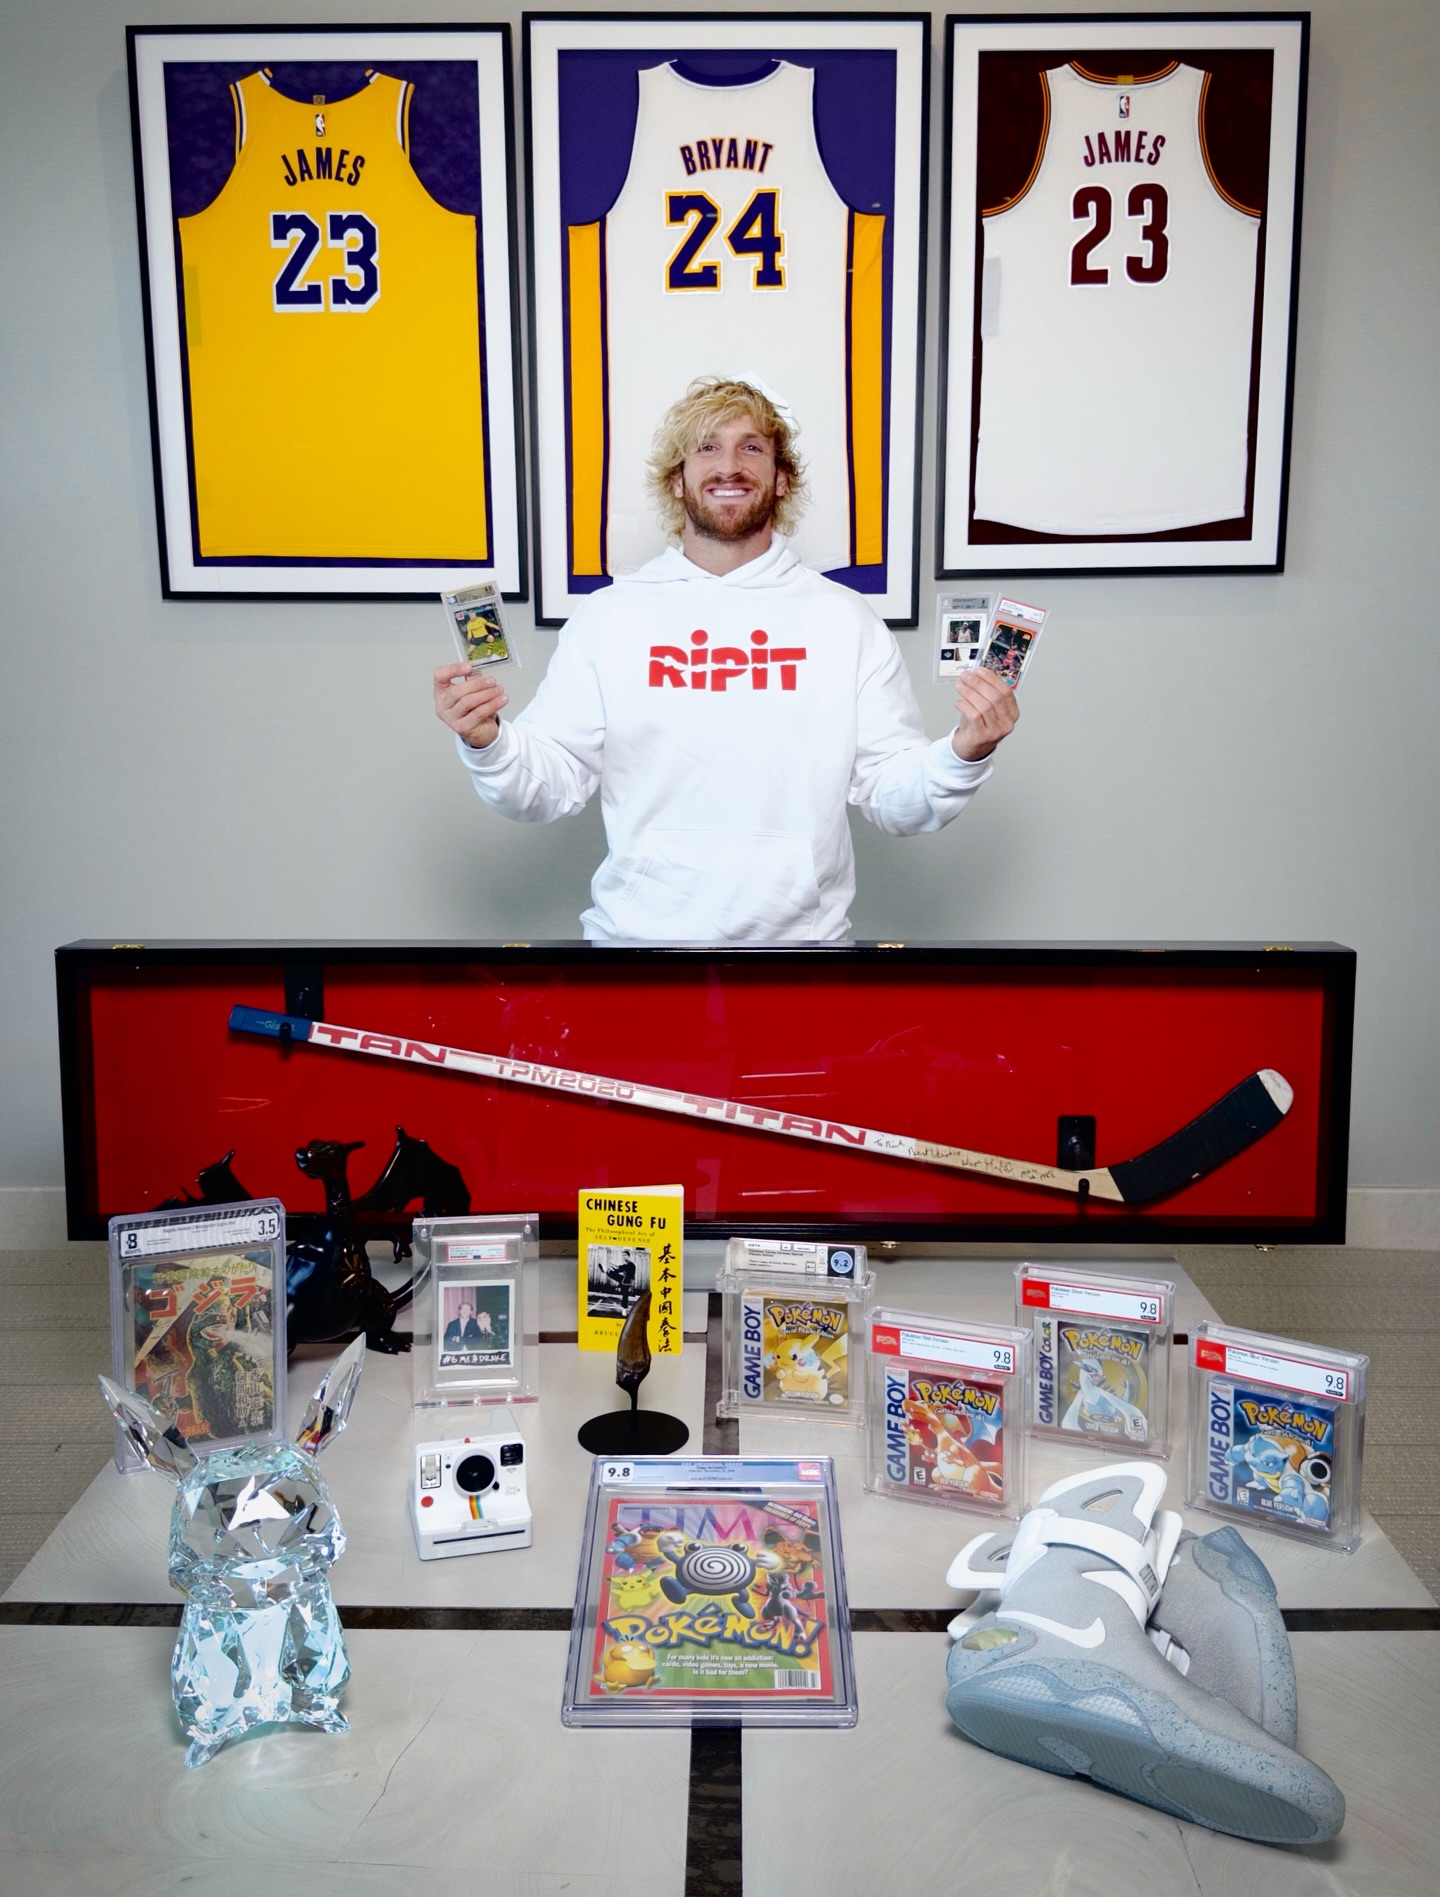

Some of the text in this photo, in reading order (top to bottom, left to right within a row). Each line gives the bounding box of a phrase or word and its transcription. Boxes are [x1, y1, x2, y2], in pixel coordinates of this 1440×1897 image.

[281, 147, 366, 187] JAMES
[680, 137, 773, 176] BRYANT
[1083, 130, 1166, 168] JAMES
[663, 188, 787, 295] 24
[1069, 182, 1170, 288] 23
[269, 211, 382, 313] 23
[494, 1053, 636, 1100] TPM2020
[683, 1095, 867, 1146] TITAN
[586, 1198, 638, 1213] CHINESE
[607, 1214, 666, 1230] GUNG FU
[258, 1218, 276, 1237] 3.5
[833, 1259, 849, 1268] 9.2
[150, 1276, 258, 1319] ゴジラ
[1140, 1301, 1157, 1315] 9.8
[479, 1353, 507, 1363] DRAKE
[744, 1305, 761, 1398] GAME BOY
[993, 1350, 1011, 1364] 9.8
[1040, 1350, 1053, 1378] BOY
[1325, 1375, 1344, 1390] 9.8
[1039, 1381, 1053, 1424] GAME
[1211, 1391, 1231, 1437] BOY
[887, 1375, 906, 1482] GAME BOY
[1132, 1418, 1141, 1427] E
[607, 1467, 631, 1477] 9.8
[916, 1471, 925, 1480] E
[1209, 1437, 1230, 1501] GAME
[1261, 1498, 1272, 1507] BLUE
[1273, 1501, 1294, 1513] VERSION
